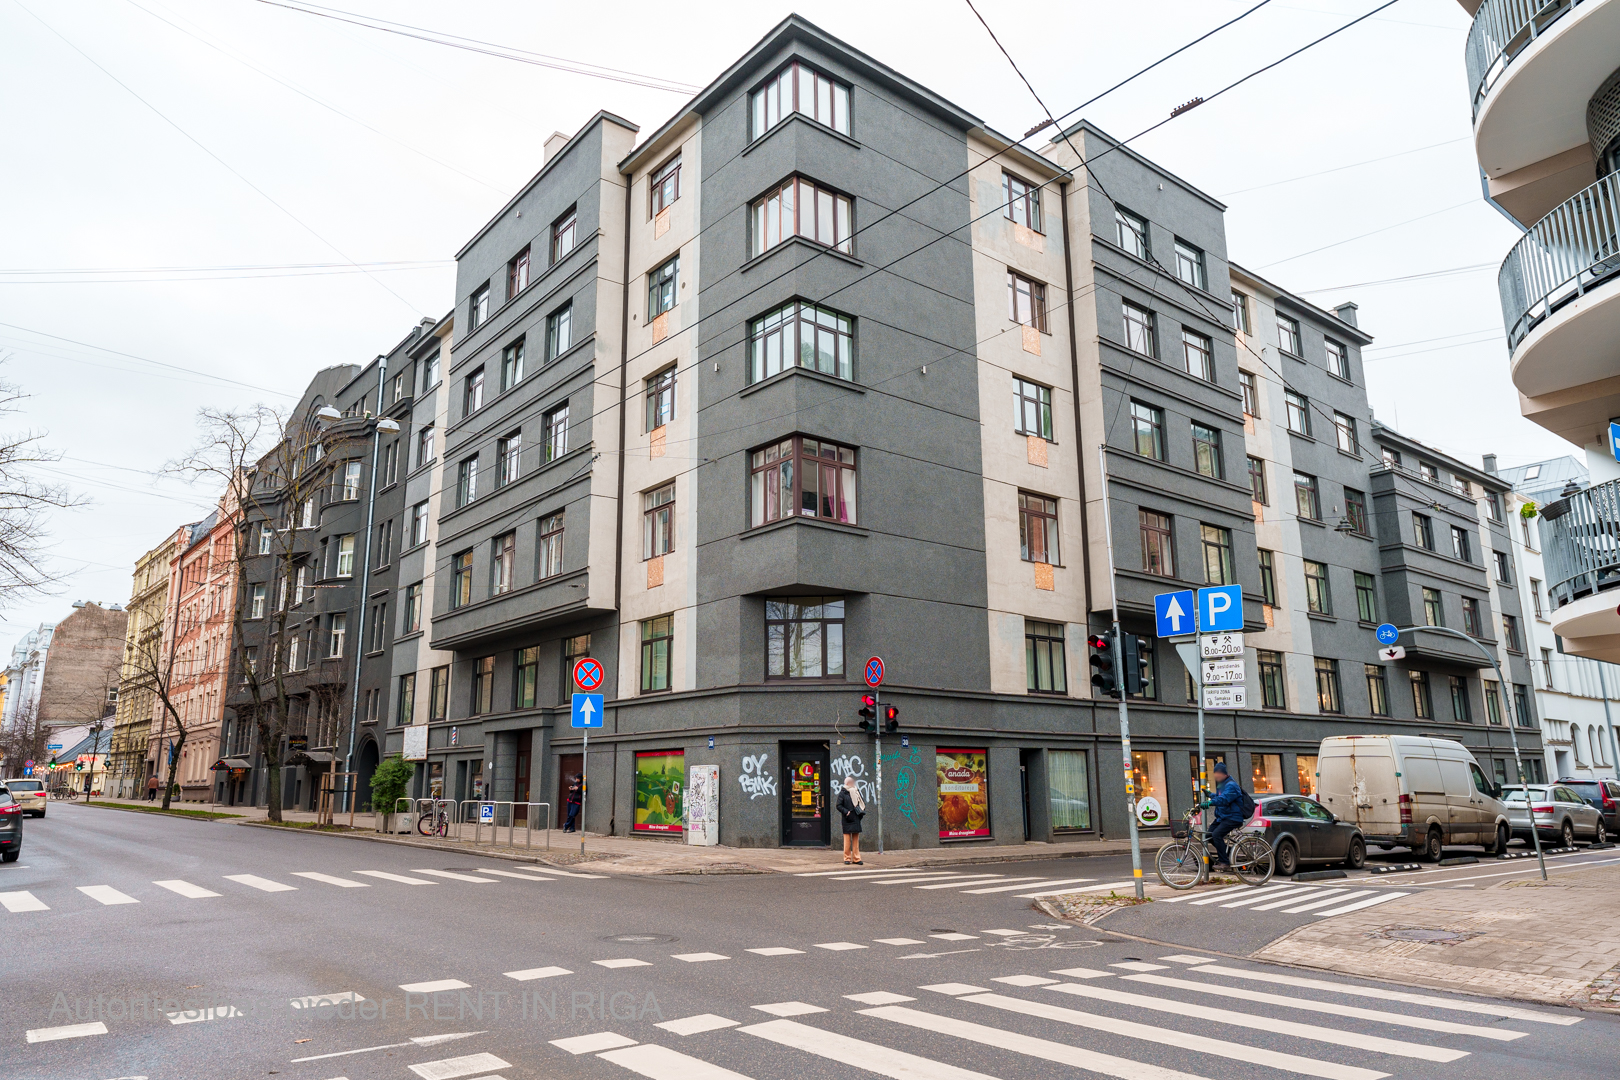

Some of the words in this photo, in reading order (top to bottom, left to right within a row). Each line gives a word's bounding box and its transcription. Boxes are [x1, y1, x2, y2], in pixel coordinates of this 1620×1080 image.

[1208, 592, 1231, 626] P
[1204, 645, 1241, 655] 8.00-20.00
[1235, 694, 1242, 702] B
[805, 766, 811, 775] L
[948, 769, 970, 777] anada
[483, 807, 489, 816] P
